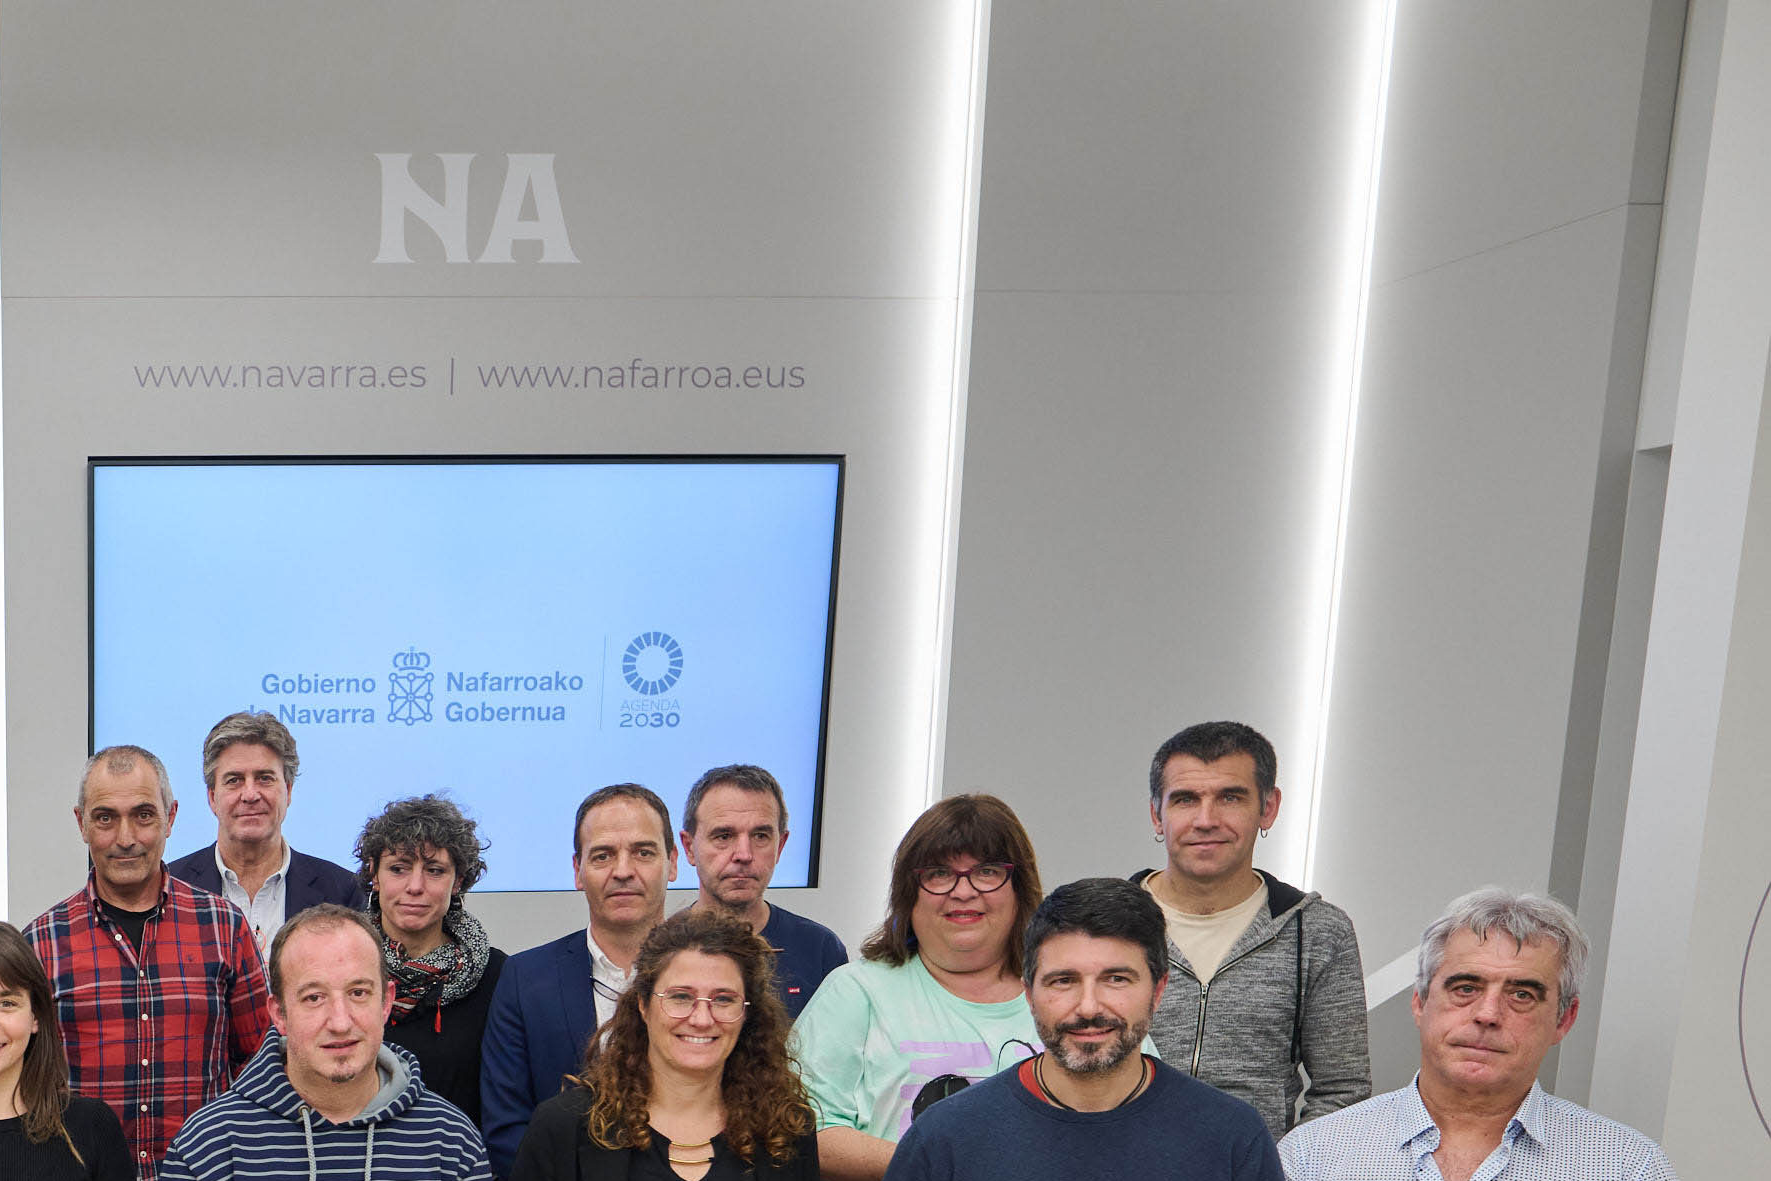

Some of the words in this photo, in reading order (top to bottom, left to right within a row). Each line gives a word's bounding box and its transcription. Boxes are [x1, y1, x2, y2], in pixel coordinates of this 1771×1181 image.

[372, 152, 581, 263] NA
[133, 364, 428, 389] www.navarra.es
[477, 357, 806, 389] www.nafarroa.eus
[261, 673, 376, 694] Gobierno
[446, 671, 584, 692] Nafarroako
[279, 703, 376, 724] Navarra
[445, 701, 566, 723] Gobernua
[620, 699, 680, 711] AGENDA
[619, 712, 680, 728] 2030
